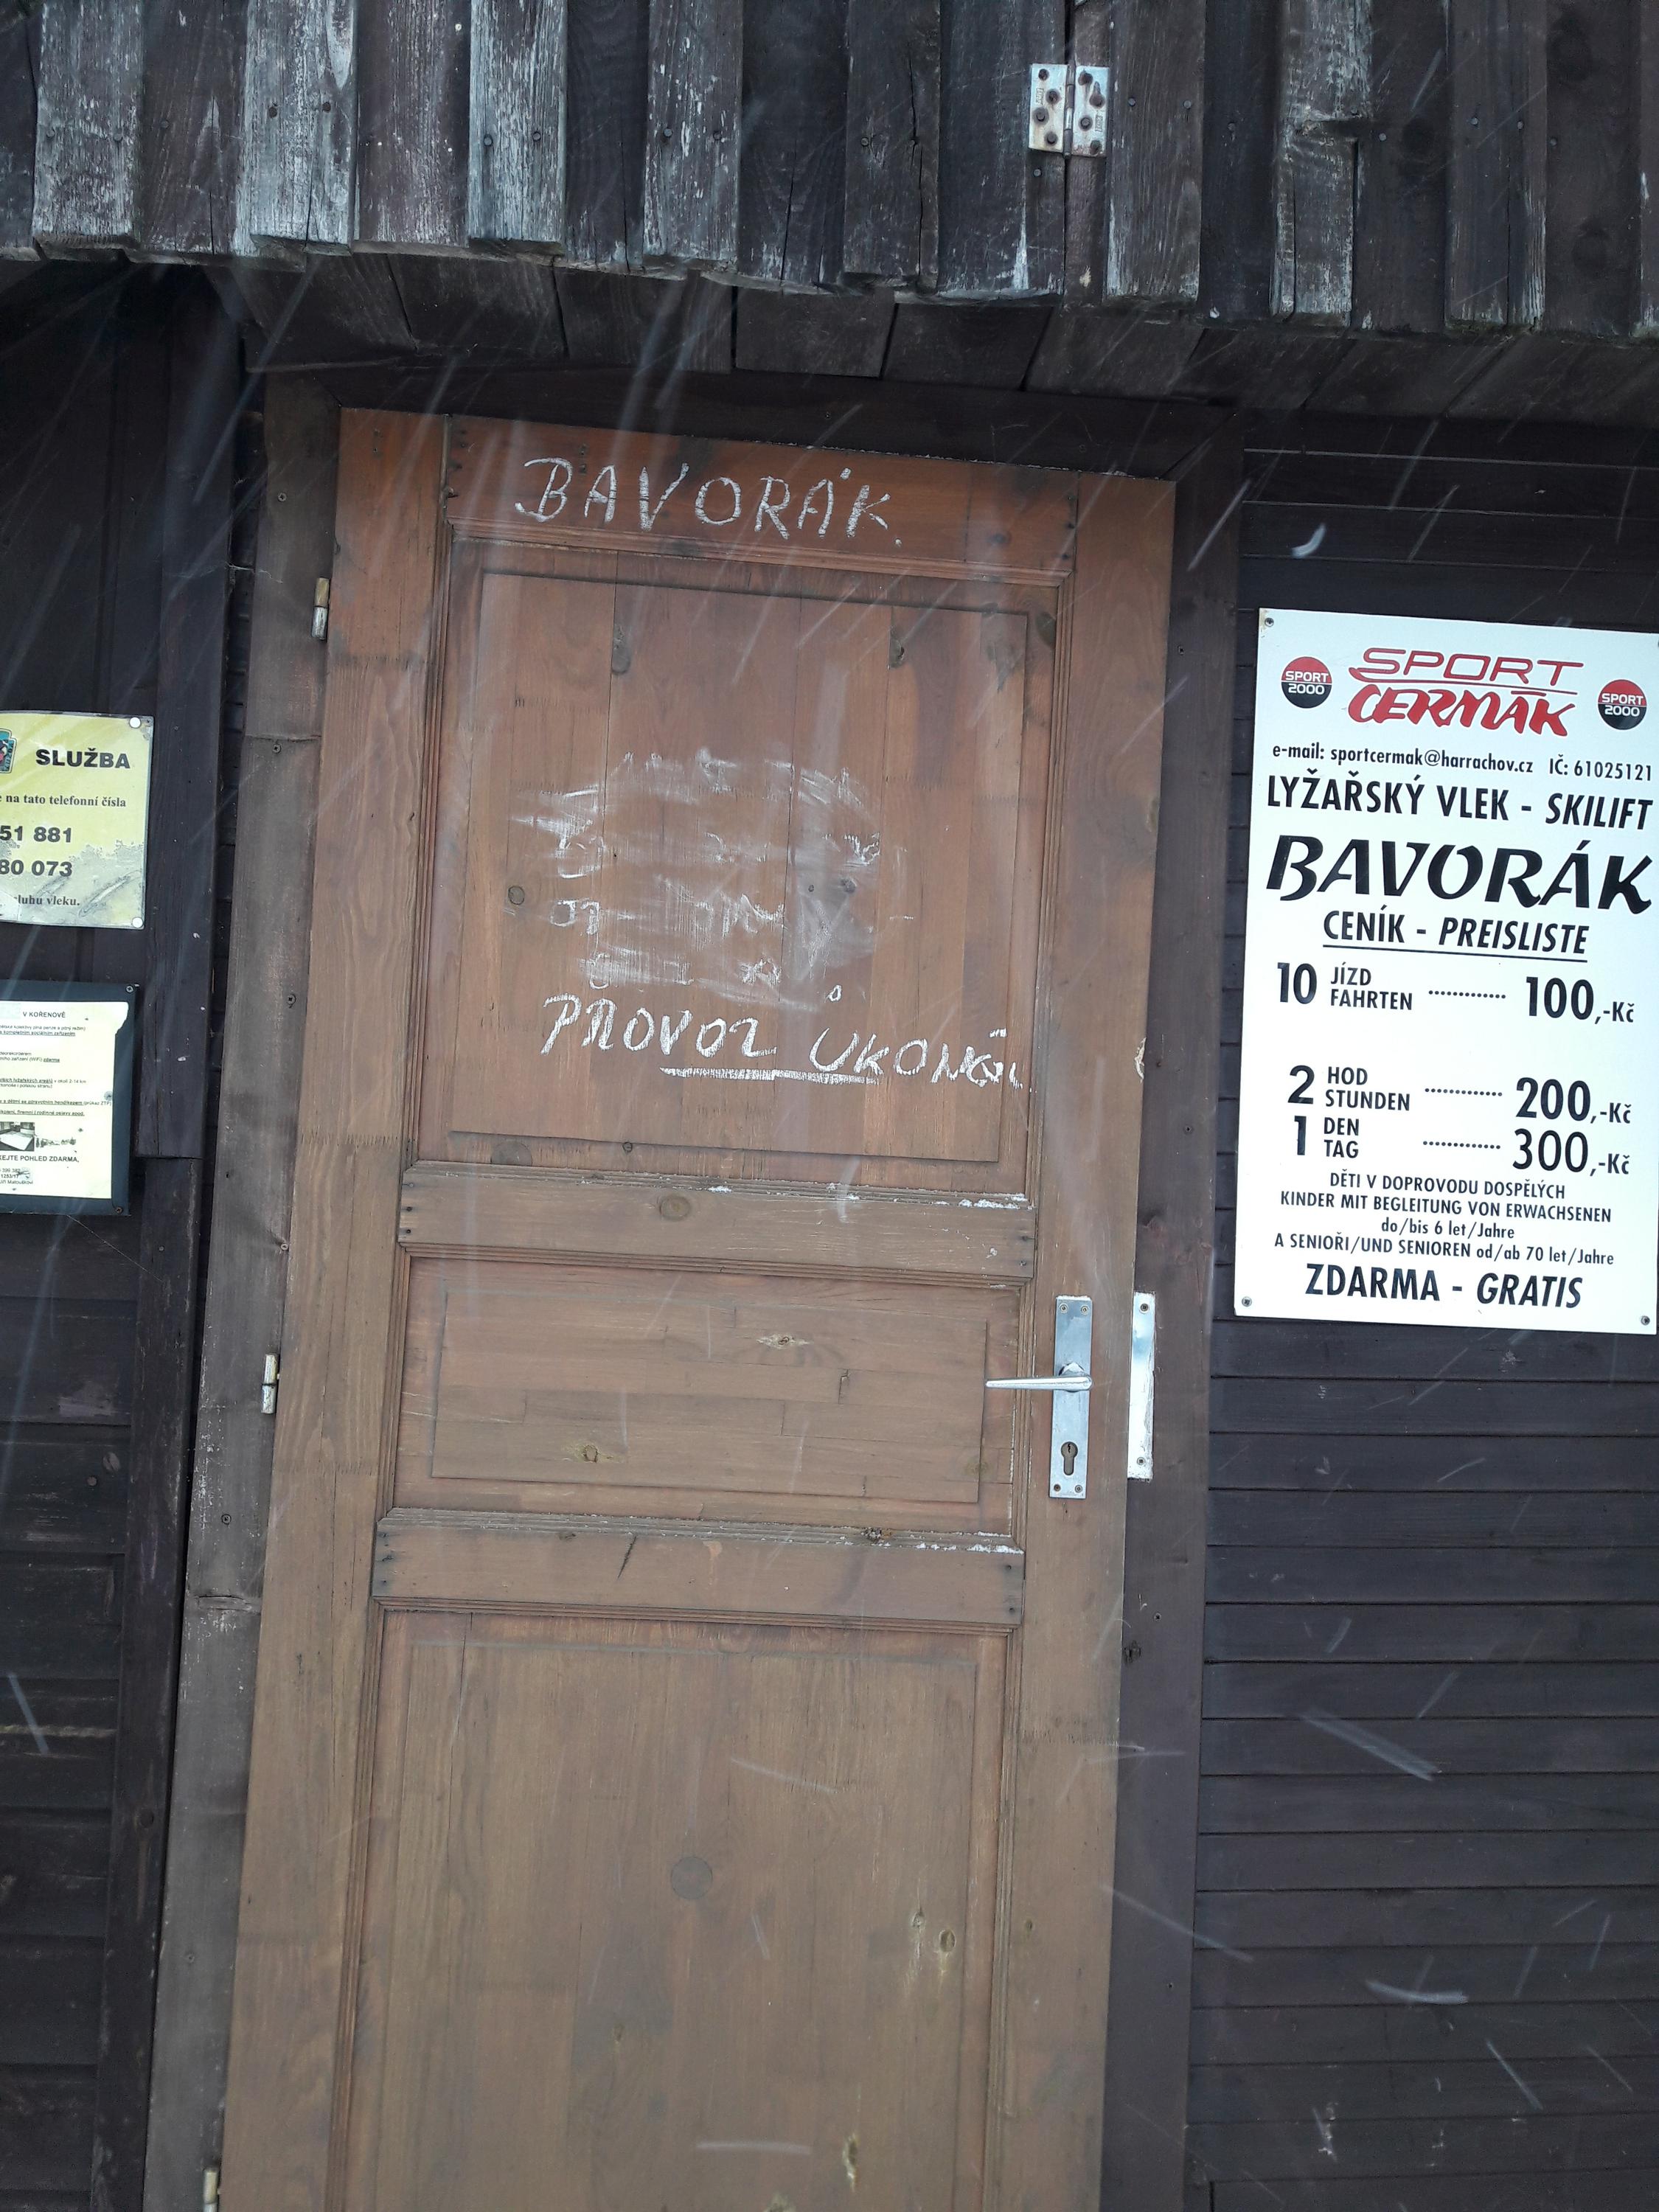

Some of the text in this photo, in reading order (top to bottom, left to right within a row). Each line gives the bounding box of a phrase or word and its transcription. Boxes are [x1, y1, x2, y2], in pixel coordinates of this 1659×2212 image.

[1285, 670, 1329, 683] SPORT
[1363, 647, 1585, 686] SPORT
[1288, 683, 1325, 695] 2000
[1601, 692, 1644, 706] SPORT
[1604, 705, 1641, 717] 2000
[35, 748, 131, 769] SLUŽBA
[1273, 742, 1651, 782] e-mail: sportcermak@harrachov.cz IČ: 61025121
[6, 794, 126, 807] na tato telefonní čísla
[1267, 768, 1425, 815] LYŽAŘSKÝ
[1436, 785, 1509, 821] VLEK
[1545, 793, 1654, 830] SKILIFT
[33, 827, 72, 843] 881
[32, 860, 72, 877] 073
[1265, 835, 1653, 915] BAVORÁK
[46, 895, 80, 906] vleku.
[1324, 904, 1405, 943] CENÍK
[1439, 917, 1590, 954] PREISLISTE
[1277, 961, 1318, 1005] 10
[1330, 961, 1371, 986] JÍZD
[1330, 988, 1413, 1011] FAHRTEN
[1287, 1065, 1315, 1105] 2
[1327, 1066, 1368, 1085] HOD
[1325, 1089, 1411, 1111] STUNDEN
[1294, 1115, 1307, 1156] 1
[1324, 1116, 1360, 1136] DEN
[1324, 1139, 1359, 1159] TAG
[1330, 1169, 1565, 1199] DĚTI V DOPROVODU DOSPĚLÝCH
[1281, 1191, 1611, 1222] KINDER MIT BEGLEITUNG VON ERWACHSENEN
[1381, 1217, 1514, 1239] do/bis 6 let/Jahre
[1274, 1231, 1614, 1266] A SENIOŘI/UND SENIOREN od/ab 70 let/Jahre
[1305, 1263, 1440, 1301] ZDARMA
[1477, 1272, 1583, 1309] GRATIS
